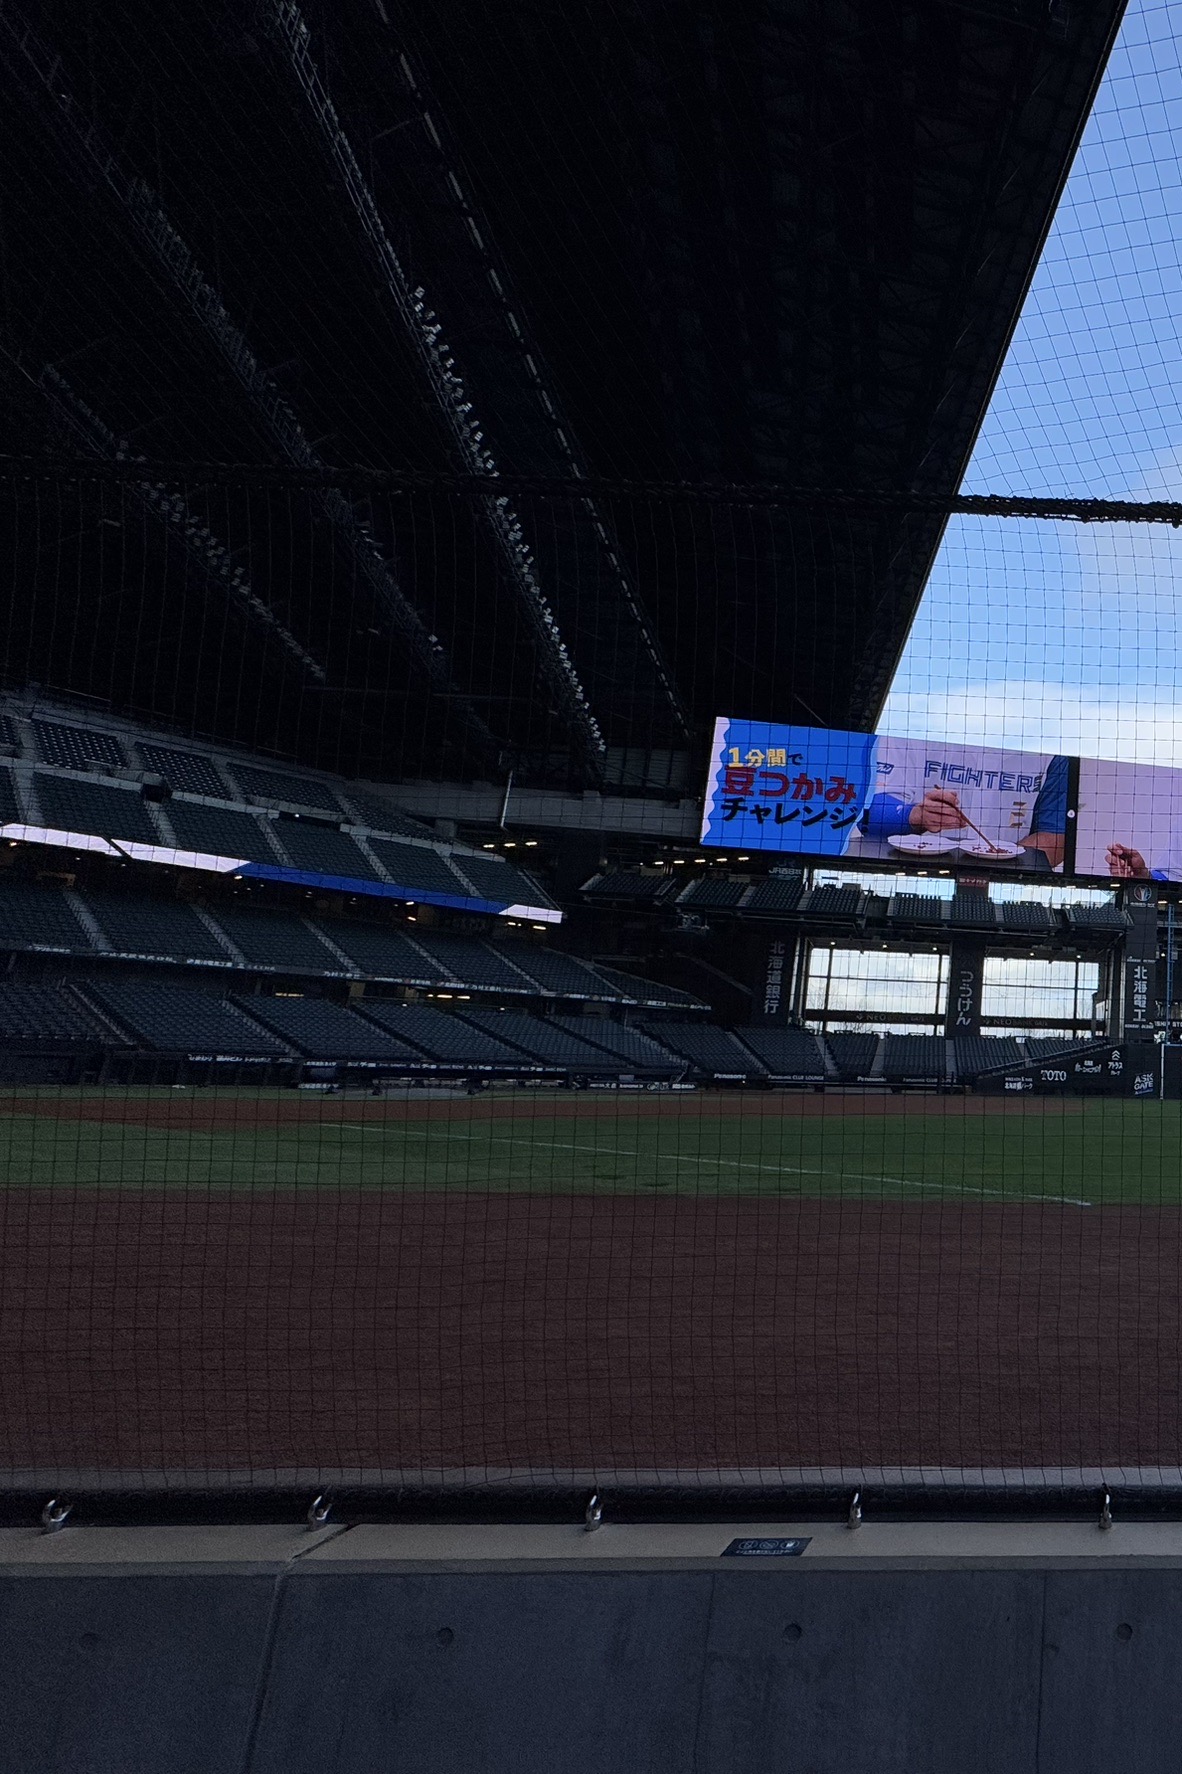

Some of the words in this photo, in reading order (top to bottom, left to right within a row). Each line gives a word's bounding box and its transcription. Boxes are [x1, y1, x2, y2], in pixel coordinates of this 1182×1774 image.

[728, 747, 803, 768] 1分間で
[722, 766, 857, 804] 豆つかみ
[764, 941, 785, 1013] 北海道銀行
[1133, 965, 1147, 1021] 北海電工
[1041, 1069, 1067, 1081] TOTO
[1134, 1073, 1154, 1084] ASK
[1134, 1081, 1154, 1091] GATE
